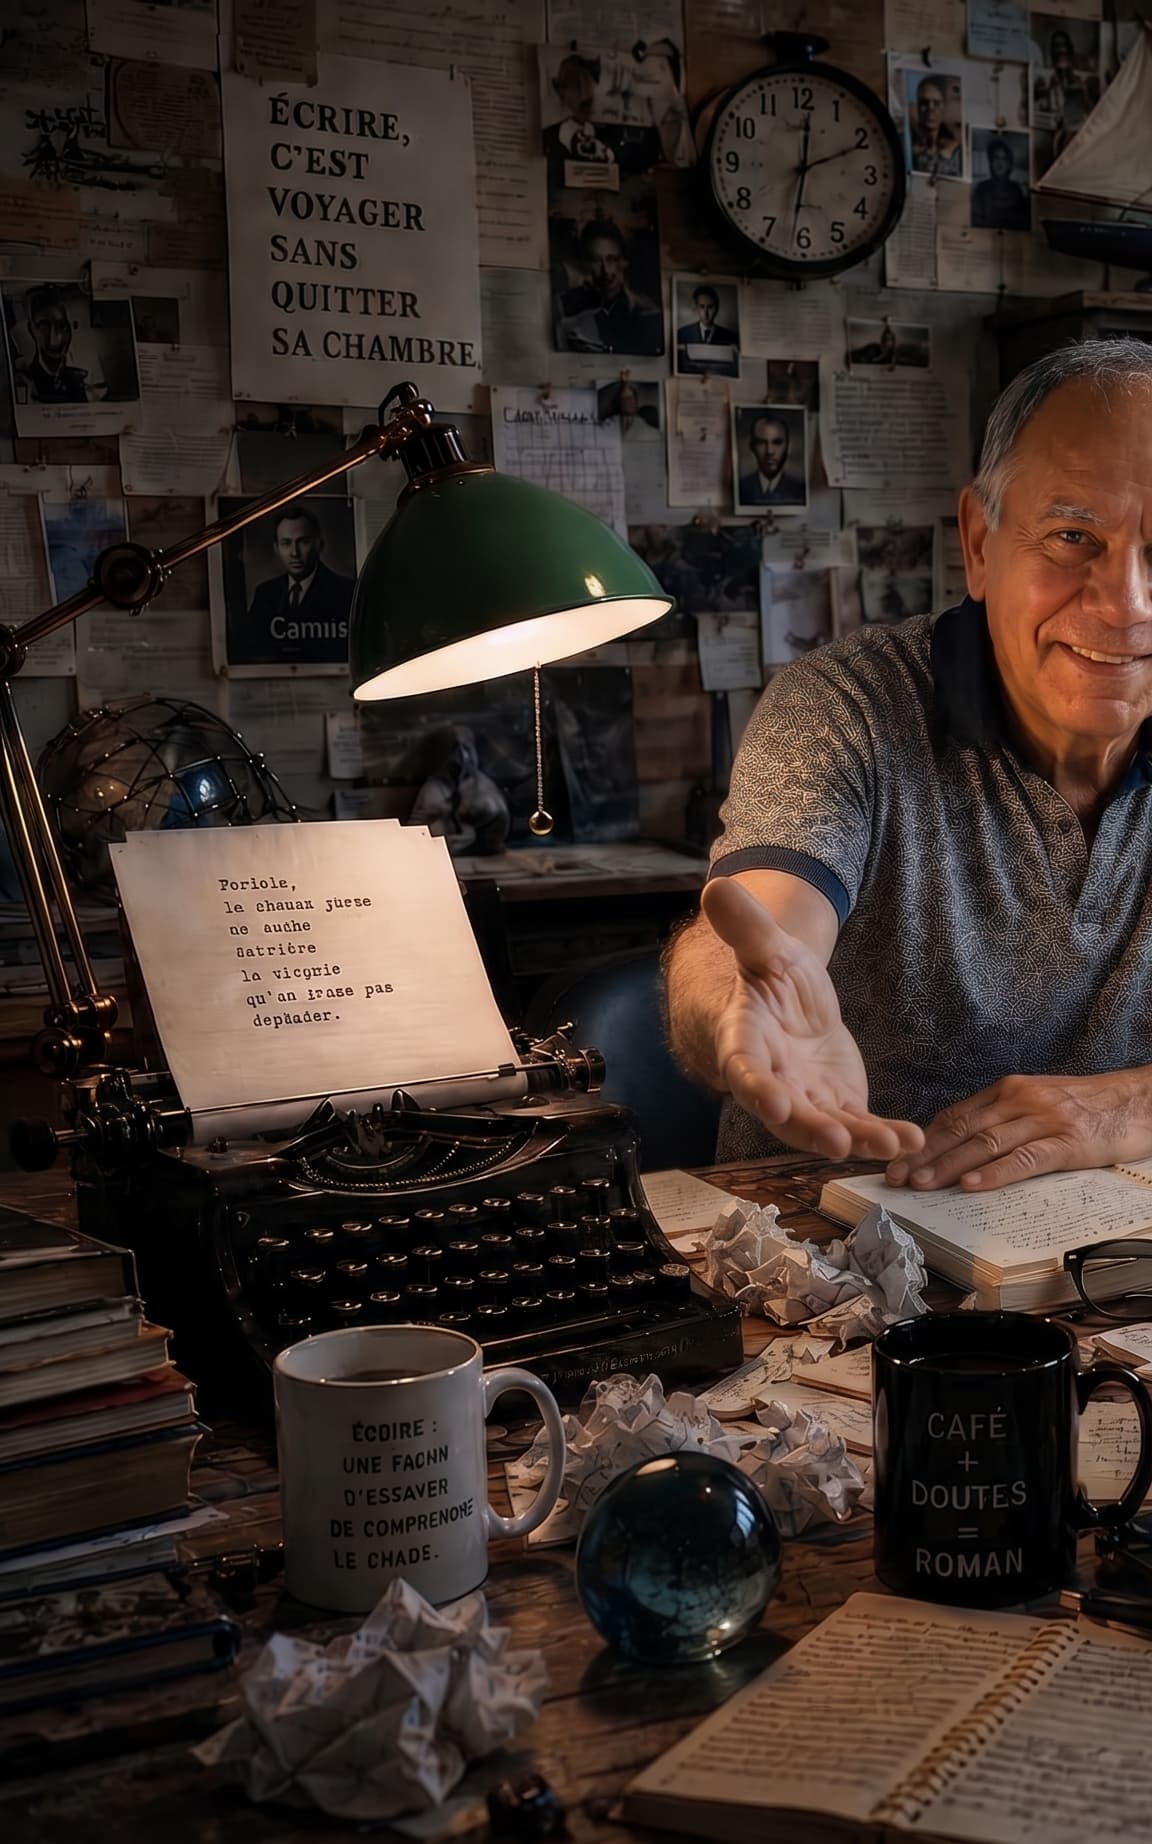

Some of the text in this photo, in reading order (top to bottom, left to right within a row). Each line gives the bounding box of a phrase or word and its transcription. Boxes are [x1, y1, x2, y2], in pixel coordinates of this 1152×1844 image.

[760, 93, 776, 117] 11
[792, 87, 814, 111] 12
[269, 92, 410, 147] ÉCRIRE,
[833, 101, 840, 122] 1
[735, 116, 755, 139] 10
[854, 128, 869, 149] 2
[271, 143, 369, 179] C’EST
[725, 151, 739, 173] 9
[864, 165, 877, 185] 3
[267, 186, 425, 231] VOYAGER
[736, 187, 751, 209] 8
[853, 197, 868, 219] 4
[762, 216, 776, 237] 7
[831, 222, 844, 242] 5
[796, 227, 811, 249] 6
[270, 234, 358, 269] SANS
[271, 280, 421, 318] QUITTER
[272, 328, 313, 356] SA
[224, 901, 244, 914] le
[242, 970, 261, 982] la
[365, 983, 394, 998] pas
[927, 1405, 1008, 1441] CAFÉ
[344, 1456, 381, 1474] UNE
[912, 1480, 1027, 1511] DOUTES
[331, 1519, 353, 1537] DE
[334, 1550, 356, 1569] LE
[915, 1546, 1024, 1579] ROMAN
